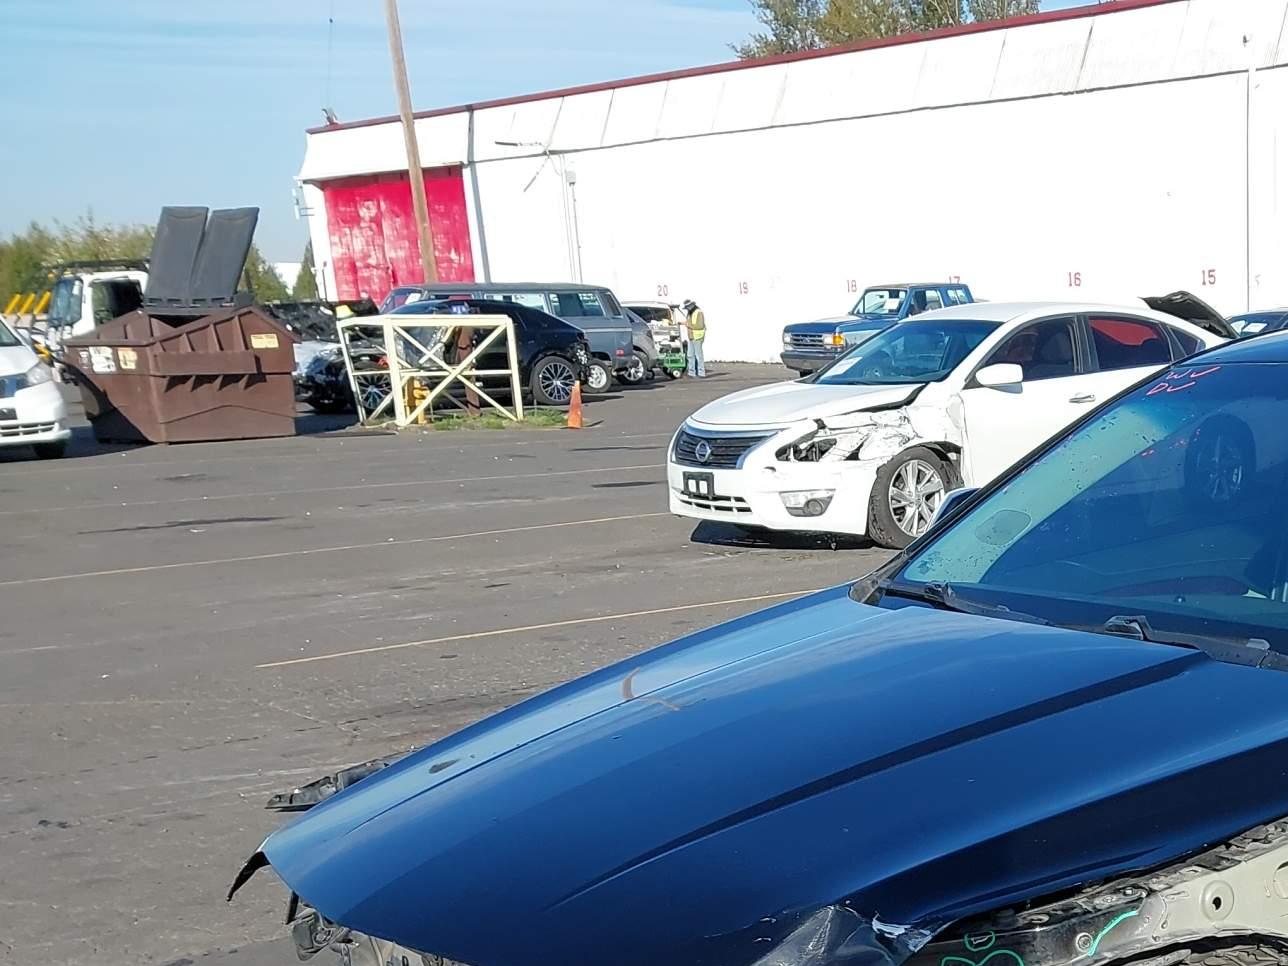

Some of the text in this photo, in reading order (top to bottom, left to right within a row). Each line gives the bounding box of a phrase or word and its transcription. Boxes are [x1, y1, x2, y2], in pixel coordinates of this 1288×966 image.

[1068, 272, 1082, 287] 16
[1201, 269, 1216, 286] 15
[657, 284, 668, 297] 20
[739, 282, 749, 295] 19
[846, 280, 857, 293] 18
